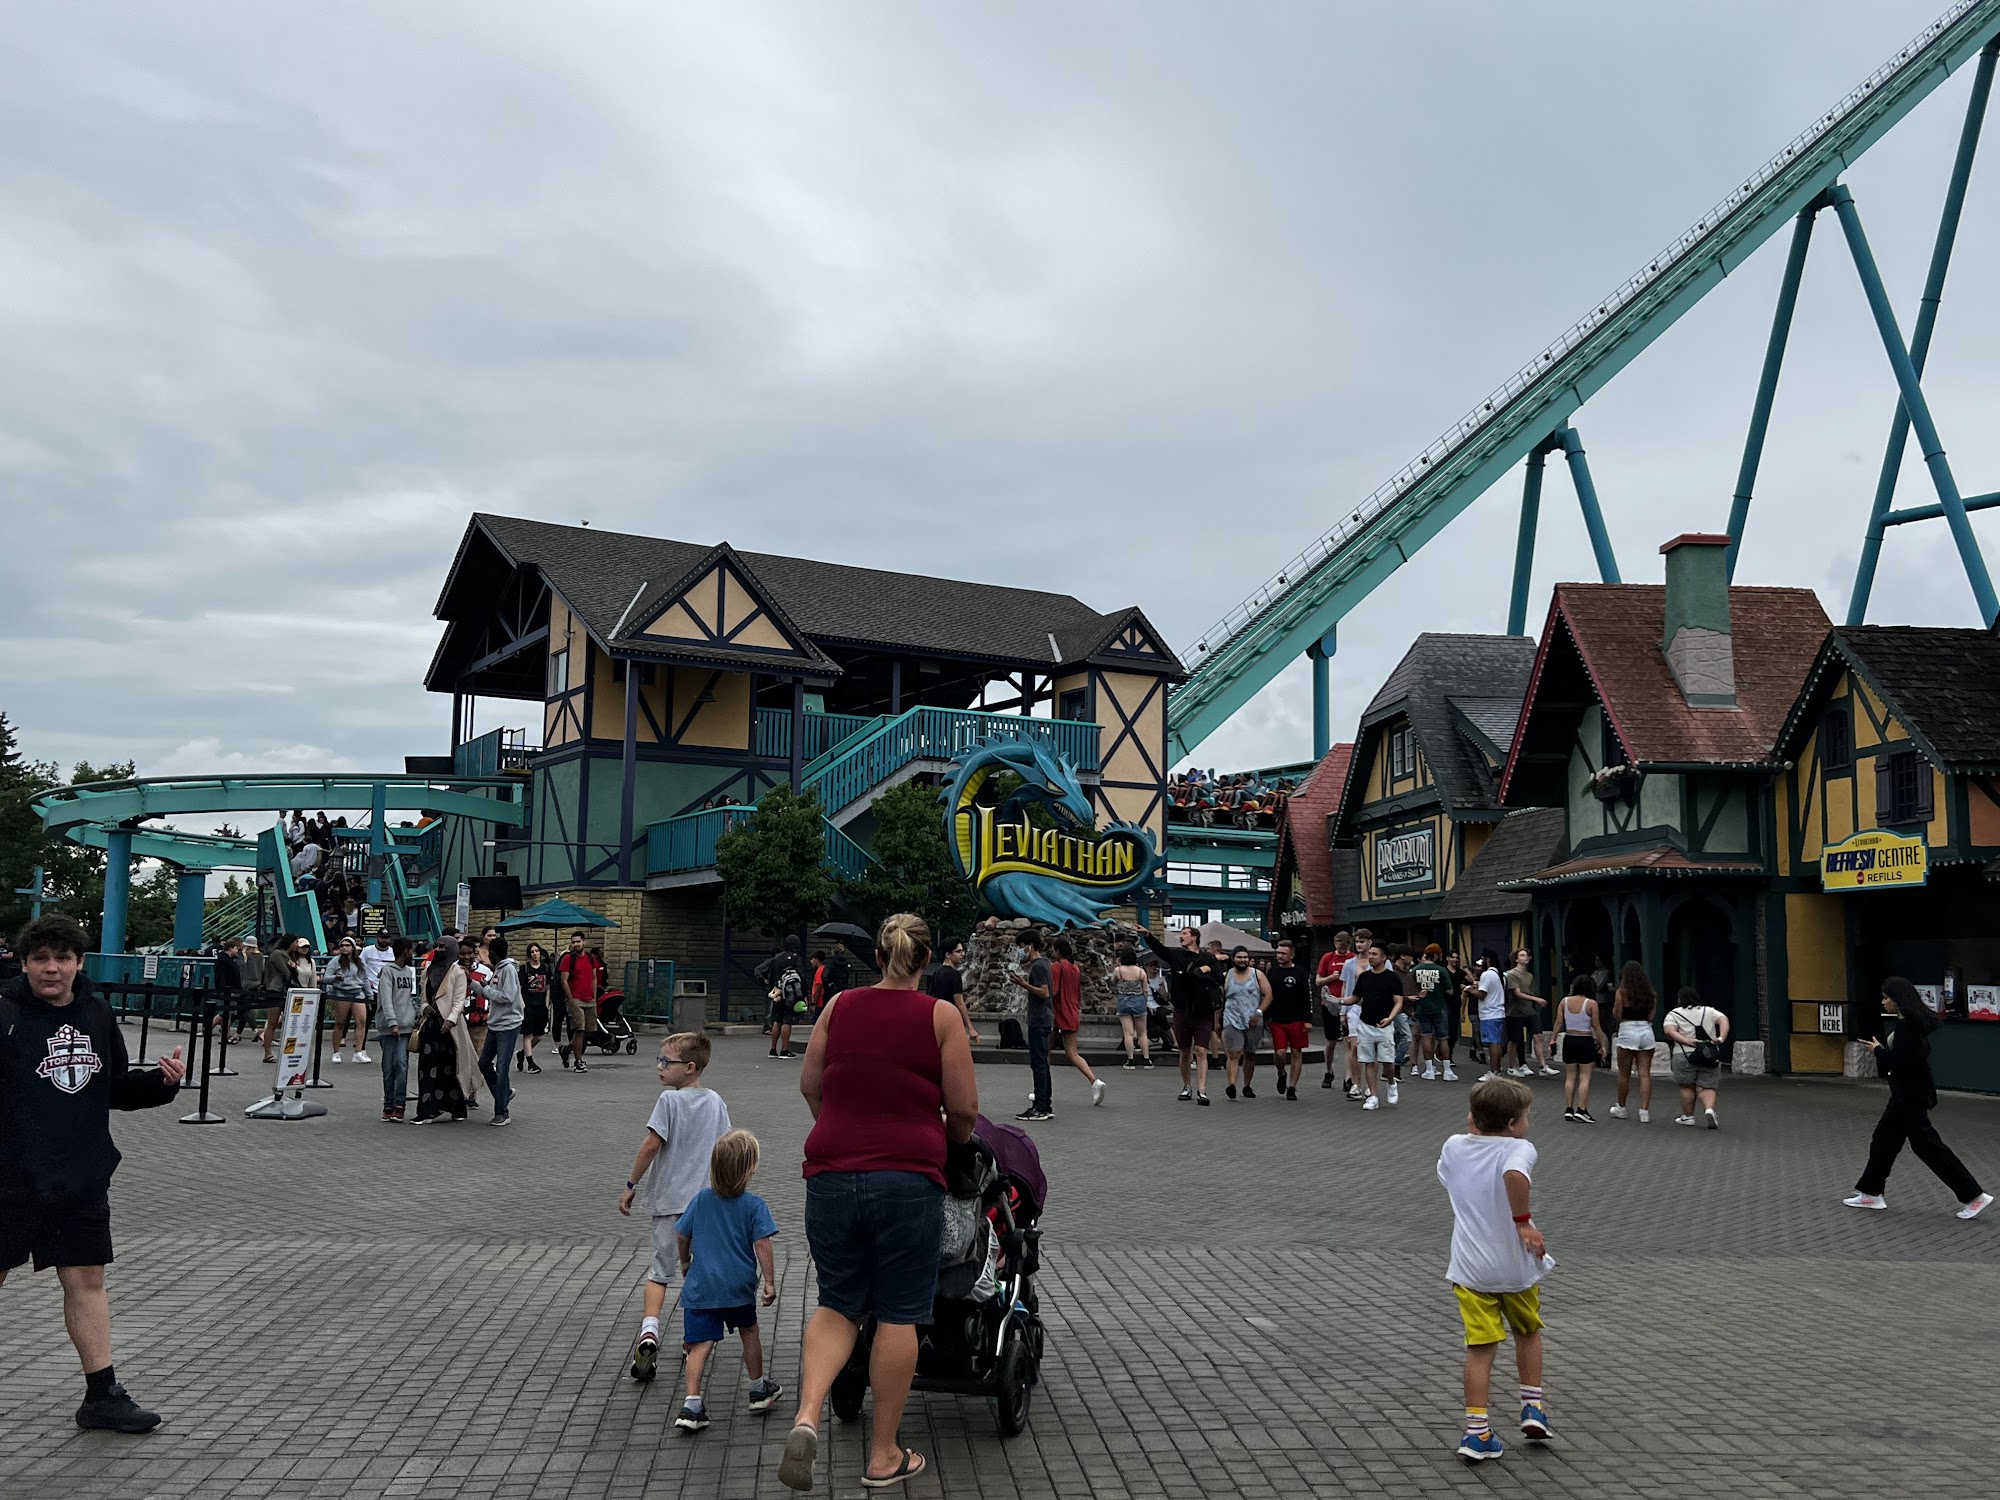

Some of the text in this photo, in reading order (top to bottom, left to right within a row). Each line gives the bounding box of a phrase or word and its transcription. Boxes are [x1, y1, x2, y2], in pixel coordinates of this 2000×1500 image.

[976, 802, 1139, 888] LEVIATHAN
[1377, 834, 1431, 876] ARCADIUM
[1878, 845, 1921, 868] CENTRE
[1867, 871, 1903, 882] REFILLS
[396, 976, 411, 989] CAT
[1823, 1004, 1840, 1017] EXIT
[1822, 1019, 1841, 1031] HERE
[47, 1055, 94, 1067] TORNTO
